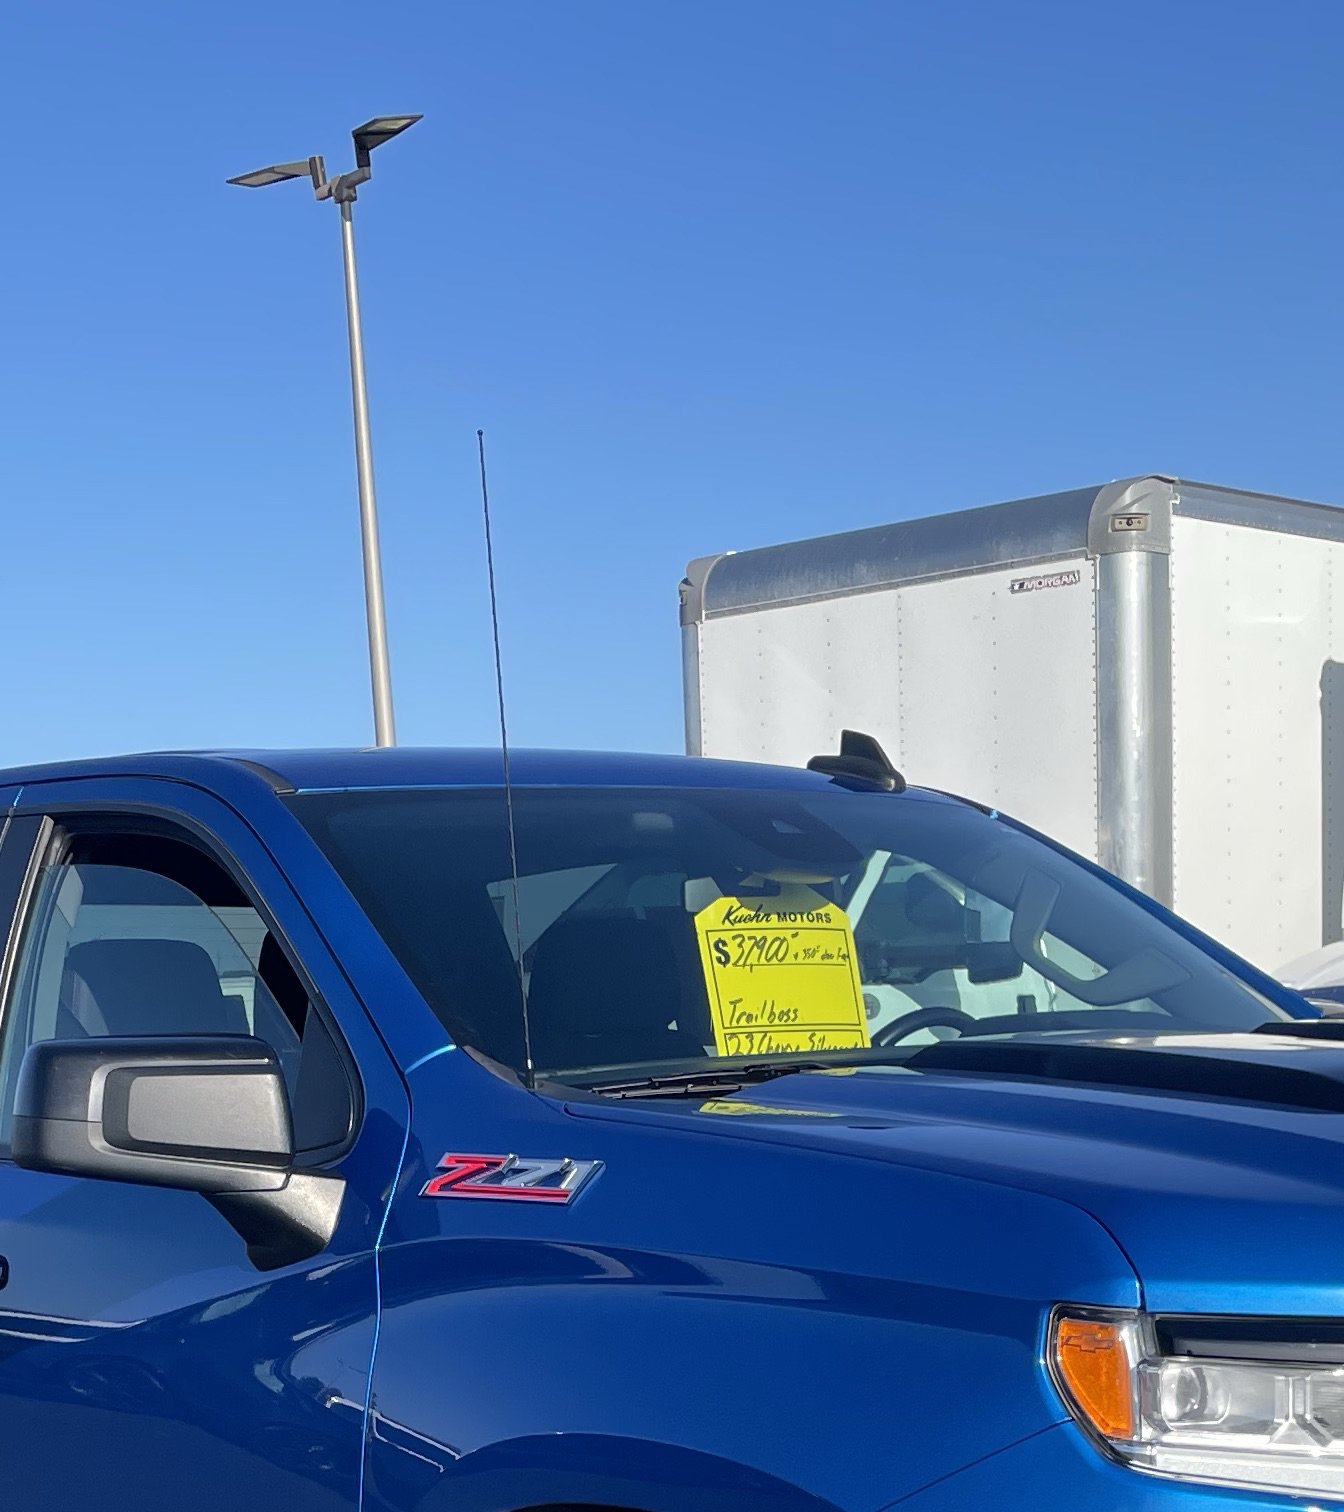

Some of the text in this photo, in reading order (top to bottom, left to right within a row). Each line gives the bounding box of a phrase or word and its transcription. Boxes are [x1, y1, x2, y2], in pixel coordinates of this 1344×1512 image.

[1023, 571, 1079, 591] MORGAN
[722, 904, 832, 926] Kuehn MOTORS
[418, 1151, 605, 1204] Z71
